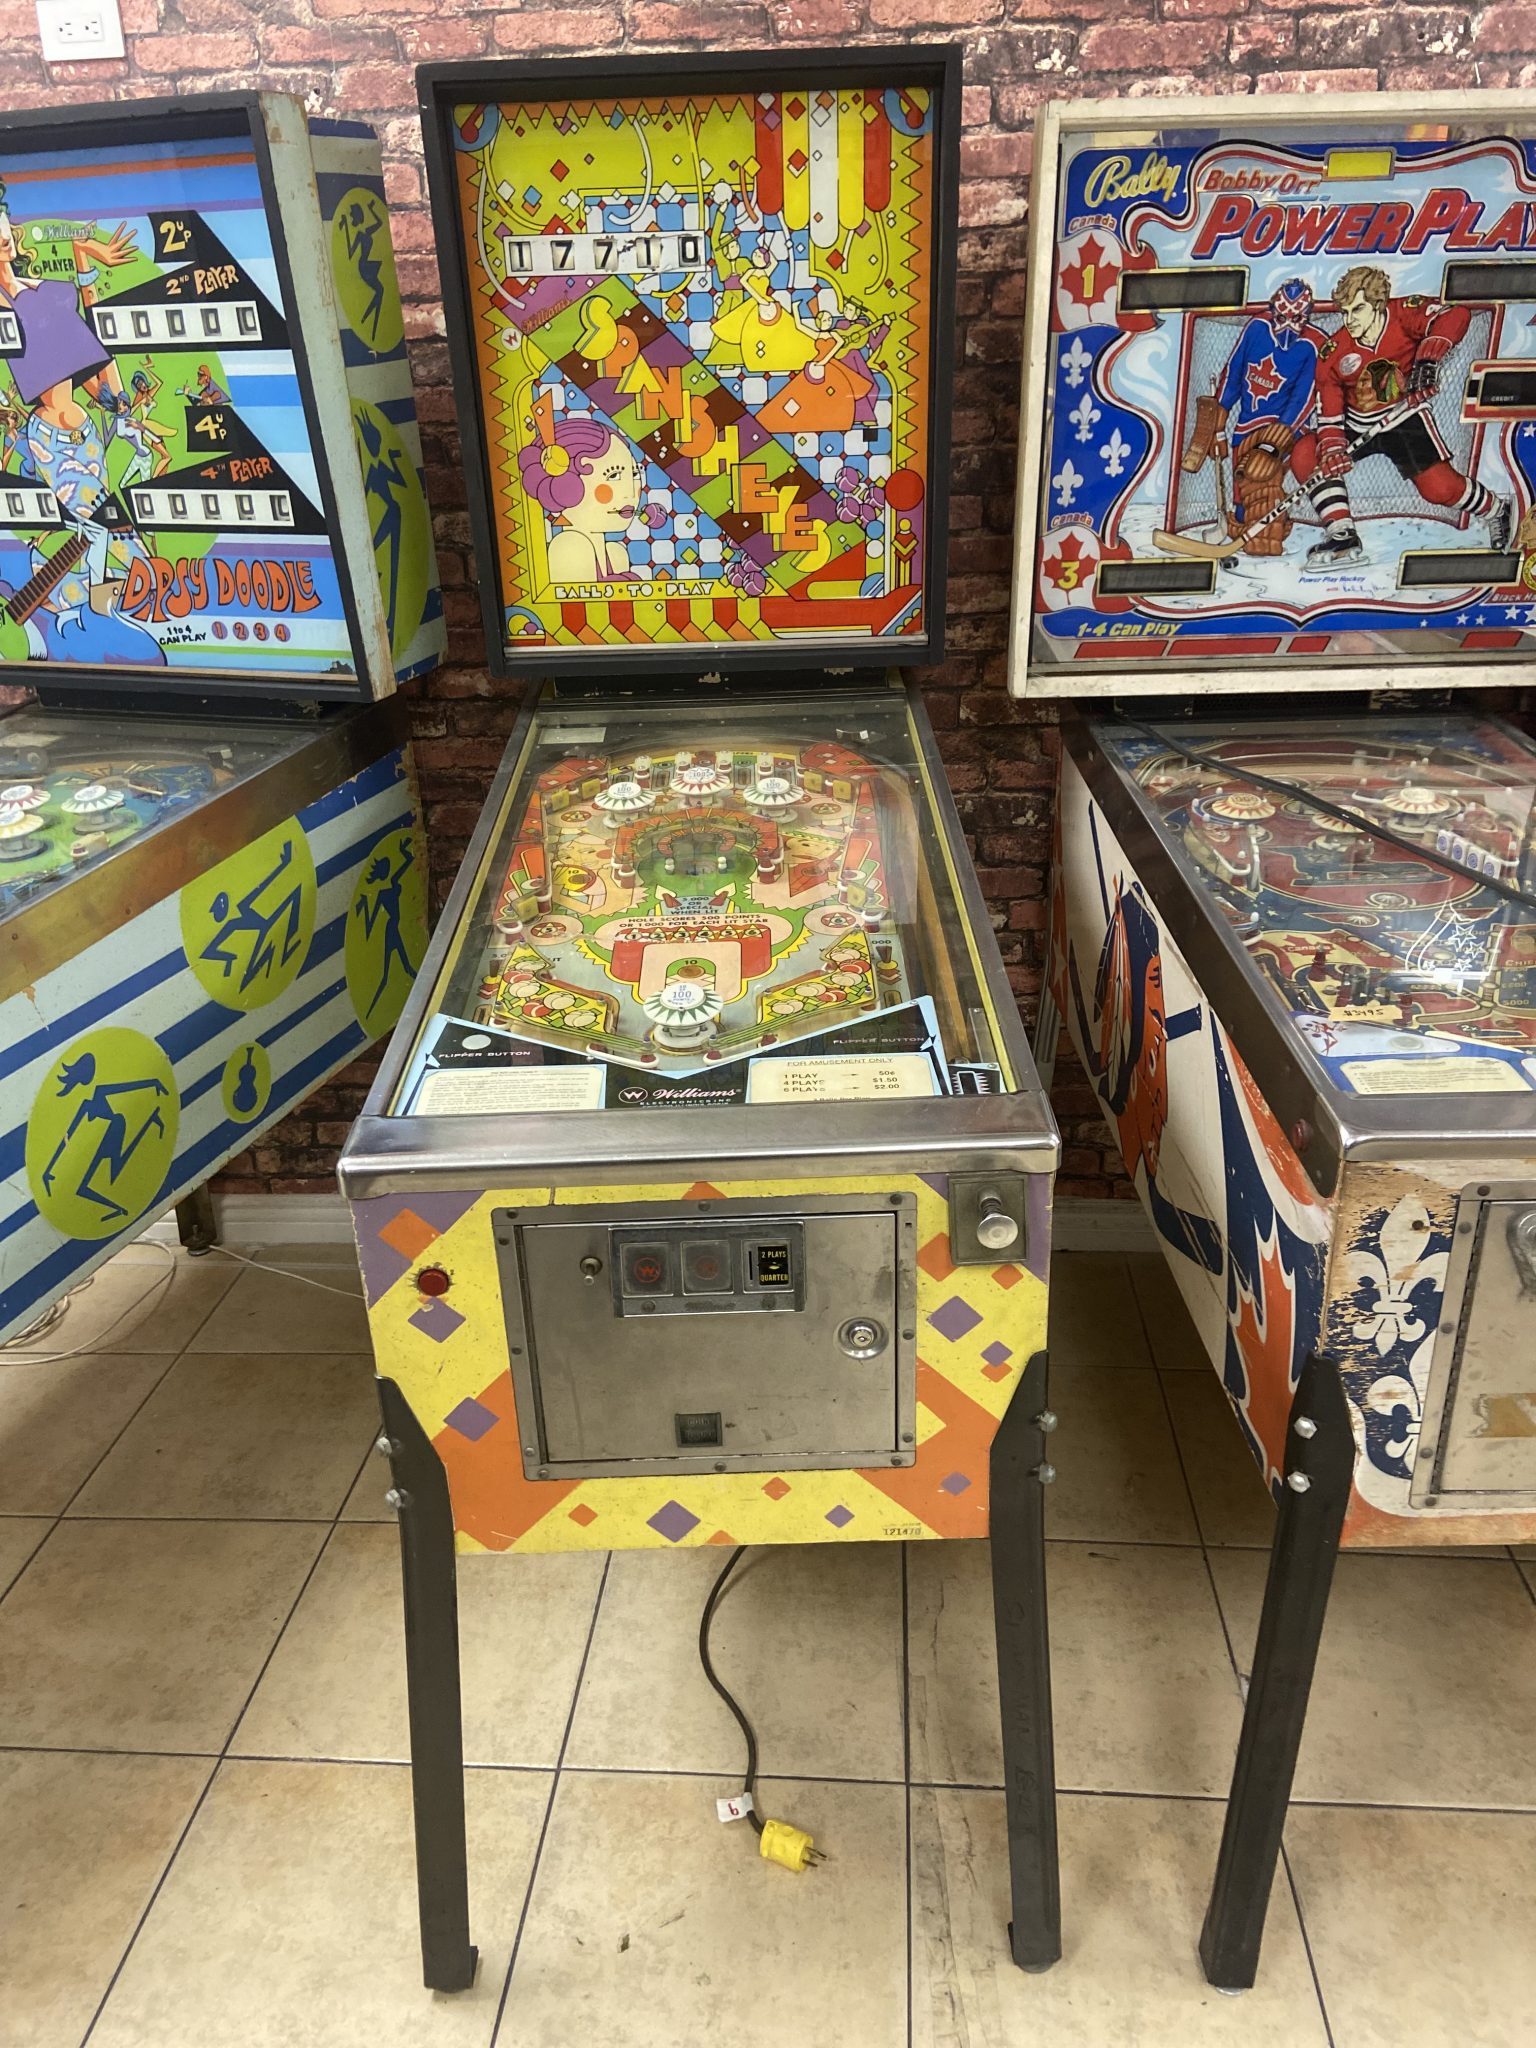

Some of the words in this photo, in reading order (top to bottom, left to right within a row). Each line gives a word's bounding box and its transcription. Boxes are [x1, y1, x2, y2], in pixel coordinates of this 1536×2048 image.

[1084, 151, 1181, 207] Bally
[1203, 170, 1276, 193] Bobby
[1279, 174, 1322, 195] Orr
[1068, 213, 1118, 232] Canada
[51, 245, 58, 257] 4
[42, 258, 75, 273] PLAYER
[194, 264, 240, 295] PLAYER
[1081, 264, 1095, 298] 1
[573, 295, 740, 476] SPANISH
[1249, 372, 1274, 390] CANADA
[229, 456, 275, 485] PLAYER
[731, 463, 832, 573] EYES
[1052, 512, 1093, 527] Canada
[1058, 561, 1080, 589] 3
[213, 558, 322, 614] DOODLE
[555, 585, 614, 599] BALLS
[627, 583, 654, 597] TO
[665, 582, 714, 596] PLAY
[159, 635, 180, 645] CAN
[182, 632, 207, 643] PLAY
[235, 623, 247, 640] 2
[255, 624, 267, 641] 3
[275, 625, 288, 641] 4
[1077, 622, 1107, 637] 1-4
[1109, 623, 1142, 636] Can
[1142, 622, 1182, 636] Play
[673, 991, 692, 999] 100
[808, 1058, 865, 1066] AMUSEMENT
[652, 1088, 737, 1100] Williams
[768, 1251, 787, 1259] PLAYS
[760, 1273, 789, 1282] QUARTER
